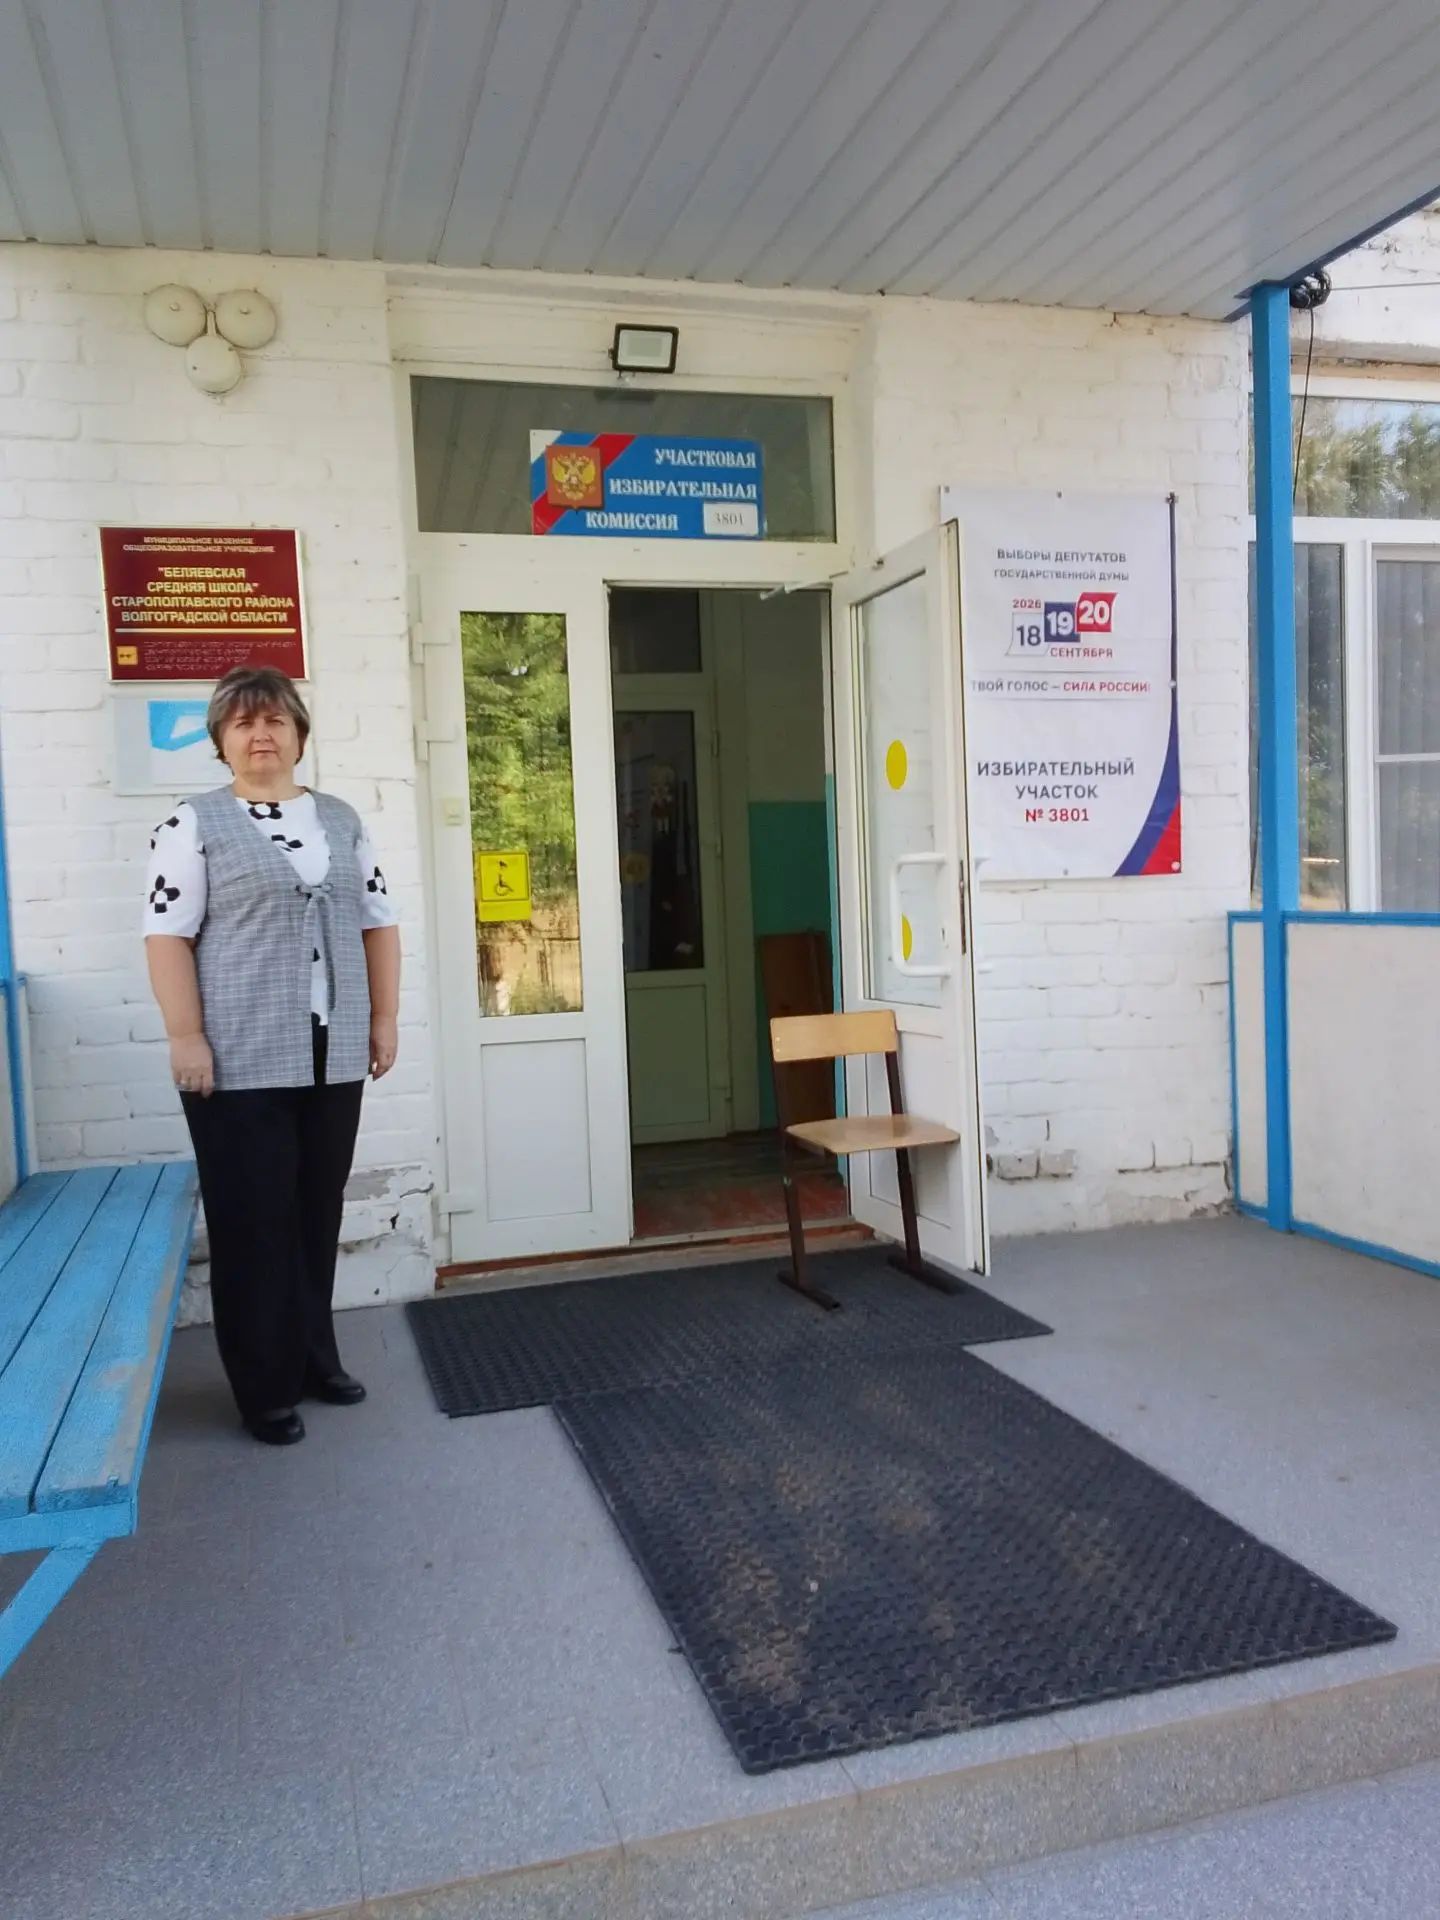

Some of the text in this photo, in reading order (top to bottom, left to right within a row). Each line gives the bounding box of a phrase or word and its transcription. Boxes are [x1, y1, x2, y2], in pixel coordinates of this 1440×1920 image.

[655, 448, 757, 468] УЧАСТКОВАЯ
[609, 478, 757, 499] ИЗБИРАТЕЛЬНАЯ
[586, 512, 679, 530] КОМИССИЯ
[143, 536, 213, 544] МУНИЦИПАЛЬНОЕ
[122, 544, 223, 552] ОБЩЕОБРАЗОВАТЕЛЬНОЕ
[997, 548, 1127, 563] ВЫБОРЫ ДЕПУТАТОВ
[158, 567, 246, 579] "БЕЛЯЕВСКАЯ
[994, 569, 1130, 581] ГОСУДАРСТВЕННОЙ ДУМЫ
[146, 582, 259, 594] СРЕДНЯЯ ШКОЛА"
[112, 595, 295, 608] СТАРОПОЛТАВСКОГО РАЙОНА
[1012, 599, 1042, 609] 2026
[121, 610, 288, 623] ВОЛГОГРАДСКОЙ ОБЛАСТИ
[1016, 600, 1110, 646] 18 19 20
[1050, 647, 1113, 658] СЕНТЯБРЯ
[1007, 681, 1048, 691] ГОЛОС
[1063, 681, 1096, 692] СИЛА
[977, 757, 1135, 777] ИЗБИРАТЕЛЬНЫЙ
[1015, 785, 1099, 799] УЧАСТОК
[1025, 808, 1090, 822] № 3801
